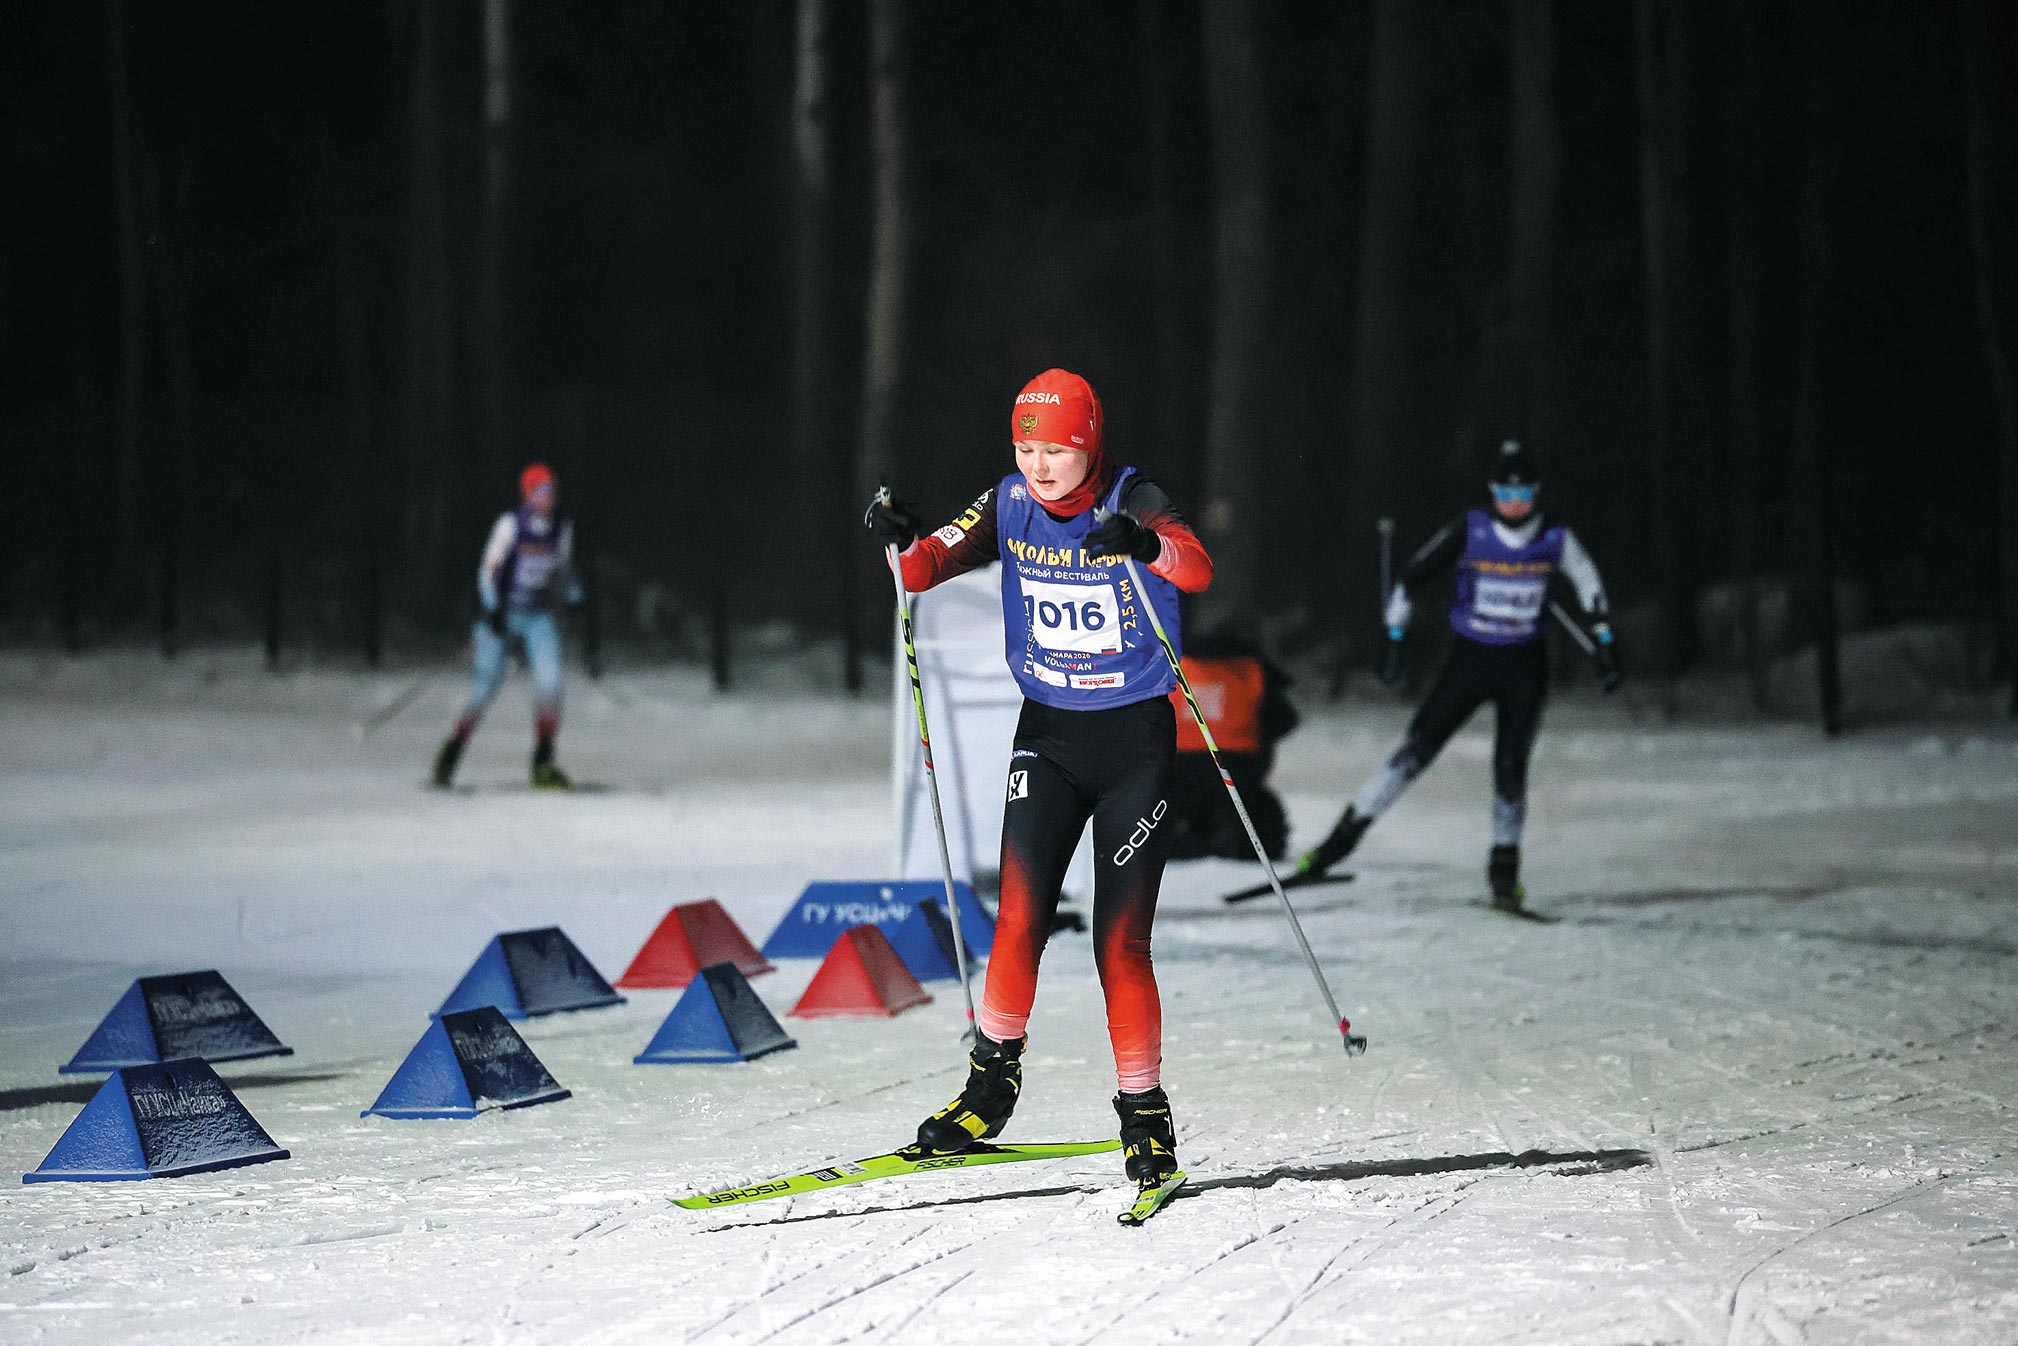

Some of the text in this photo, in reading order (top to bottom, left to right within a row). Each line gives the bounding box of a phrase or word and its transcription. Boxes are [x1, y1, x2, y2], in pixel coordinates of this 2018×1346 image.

[1015, 392, 1061, 406] RUSSIA
[1016, 561, 1110, 582] ЖНЫЙ ФЕСТИВАЛЬ
[1022, 595, 1106, 632] 1016
[1121, 605, 1138, 631] 2,5
[1047, 650, 1072, 660] МАРА
[1113, 799, 1168, 867] odlo
[912, 1156, 967, 1171] FISCHER
[708, 1180, 791, 1204] FISCHER
